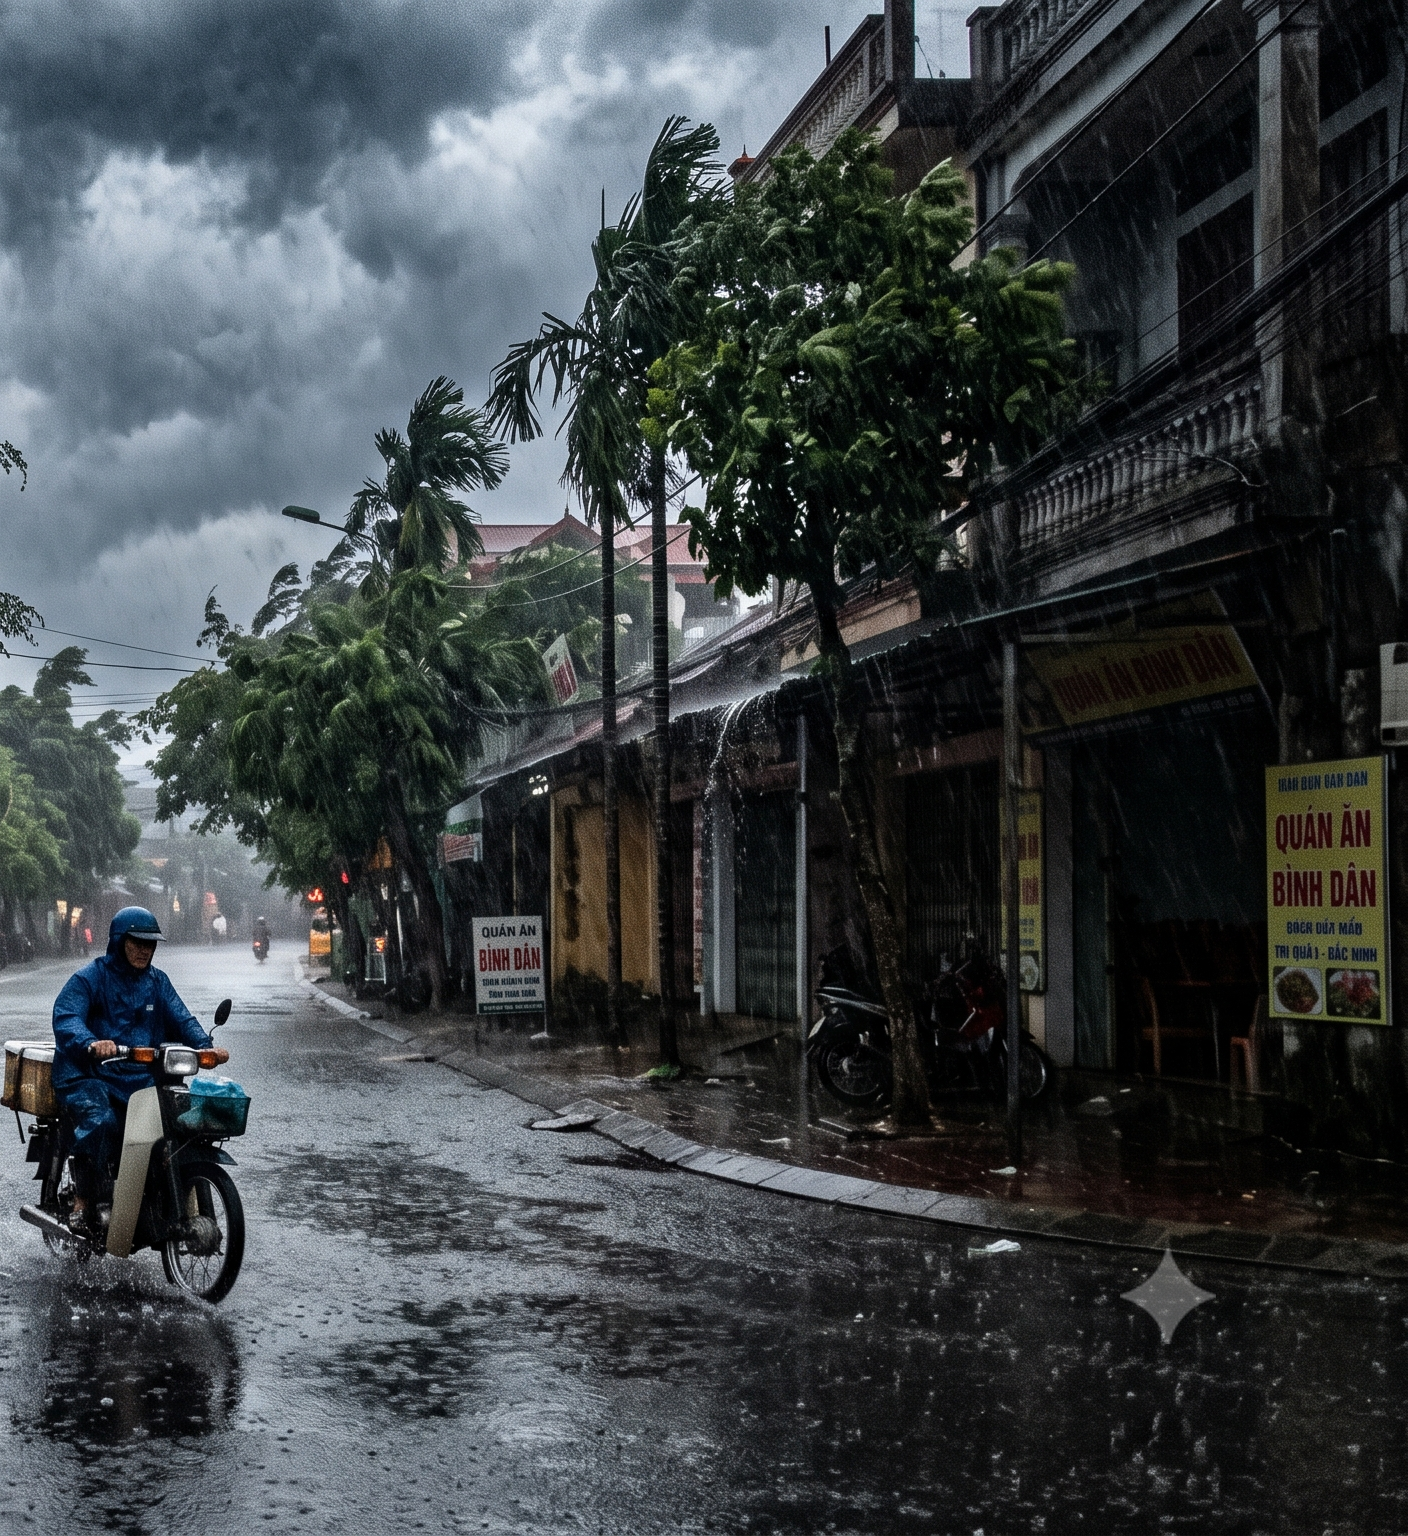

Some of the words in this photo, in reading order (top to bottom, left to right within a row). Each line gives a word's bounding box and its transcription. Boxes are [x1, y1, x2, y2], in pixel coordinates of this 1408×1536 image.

[1181, 631, 1241, 684] DÂN
[1276, 805, 1332, 854] QUÁN
[1340, 802, 1371, 848] ĂN
[1273, 863, 1322, 907] BÌNH
[1330, 862, 1376, 907] DÂN
[482, 923, 515, 938] QUÁN
[479, 943, 510, 972] BÌNH
[514, 942, 541, 971] DÂN
[1351, 947, 1377, 962] NINH
